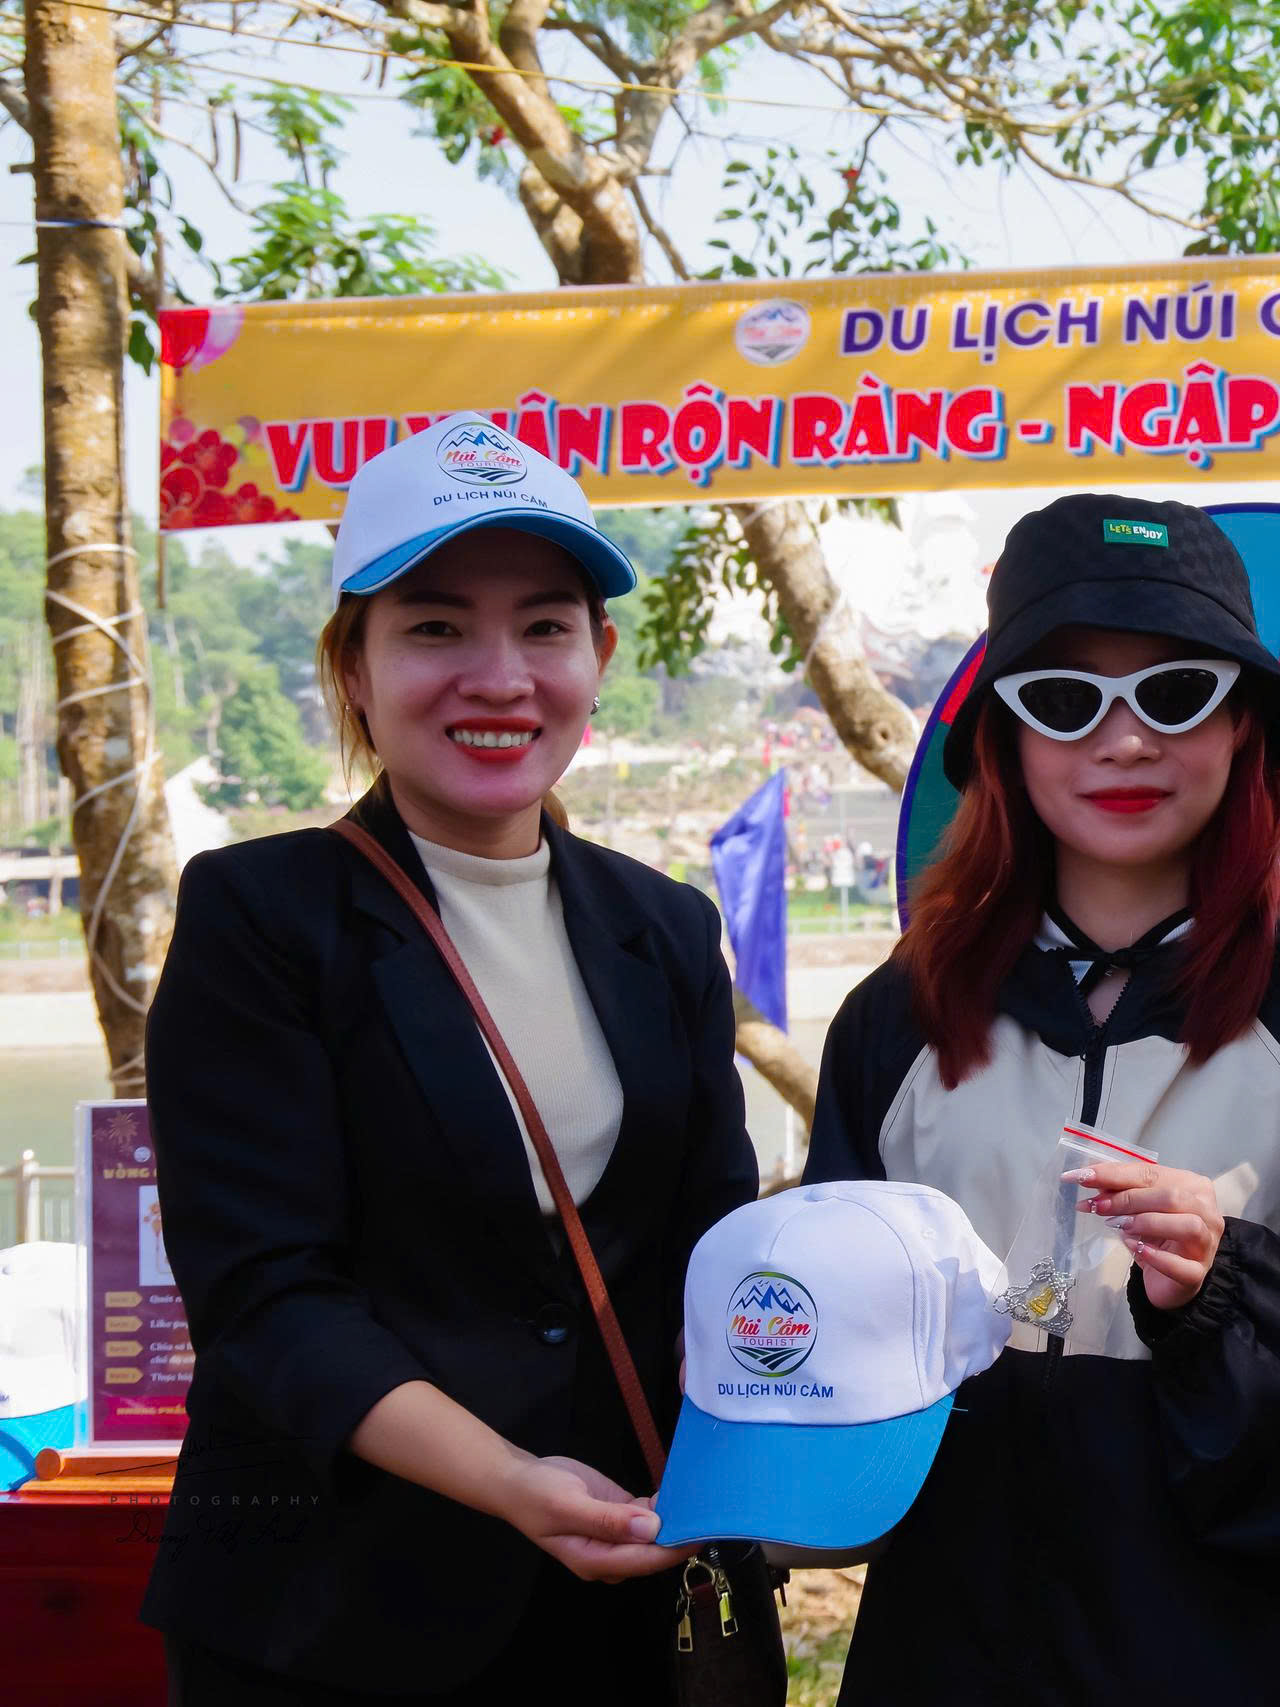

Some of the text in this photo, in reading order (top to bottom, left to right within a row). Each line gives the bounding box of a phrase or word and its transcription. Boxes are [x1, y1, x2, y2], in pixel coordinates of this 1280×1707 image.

[841, 309, 927, 355] DU
[952, 299, 1101, 363] LỊCH
[1125, 283, 1236, 344] NÚI
[266, 417, 395, 489] VUI
[620, 380, 777, 485] RỘN
[790, 374, 1002, 464] RÀNG
[433, 494, 452, 506] DU
[493, 488, 517, 499] NÚI
[1132, 526, 1163, 539] ENJOY
[730, 1315, 811, 1336] Núi Cấm
[742, 1338, 796, 1346] TOURIST
[718, 1383, 734, 1396] DU
[737, 1383, 770, 1398] LỊCH
[775, 1381, 797, 1396] NÚI
